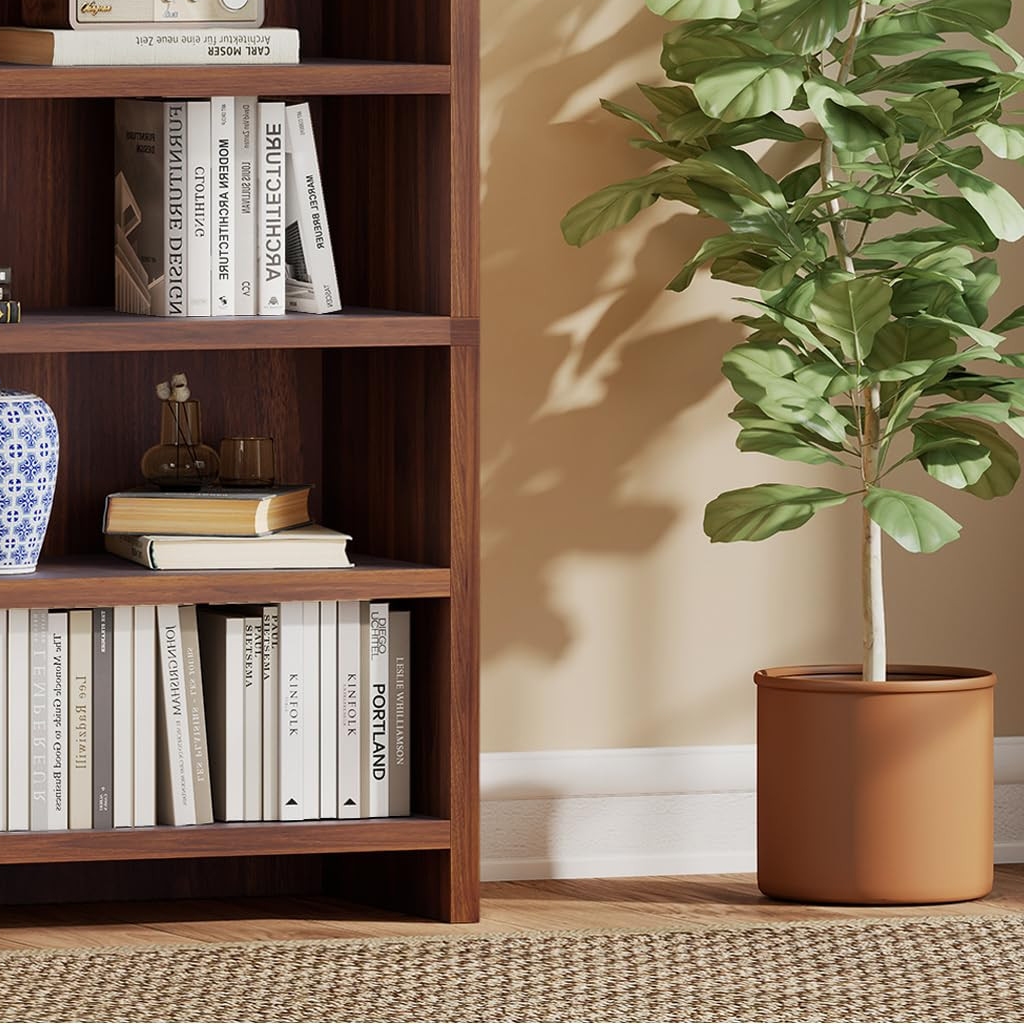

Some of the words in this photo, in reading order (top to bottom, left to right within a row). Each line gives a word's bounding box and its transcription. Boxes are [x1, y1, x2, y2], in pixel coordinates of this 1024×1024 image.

[135, 36, 154, 47] Zeit
[156, 36, 179, 44] neue
[181, 36, 201, 46] eine
[219, 35, 271, 46] Architektur
[207, 46, 241, 56] MOSER
[245, 46, 270, 56] CARL
[254, 625, 262, 657] PAUL
[378, 617, 387, 654] DIEGO
[396, 657, 404, 689] LESLIE
[289, 673, 299, 736] KINFOLK
[347, 673, 357, 736] KINFOLK
[372, 683, 386, 781] PORTLAND
